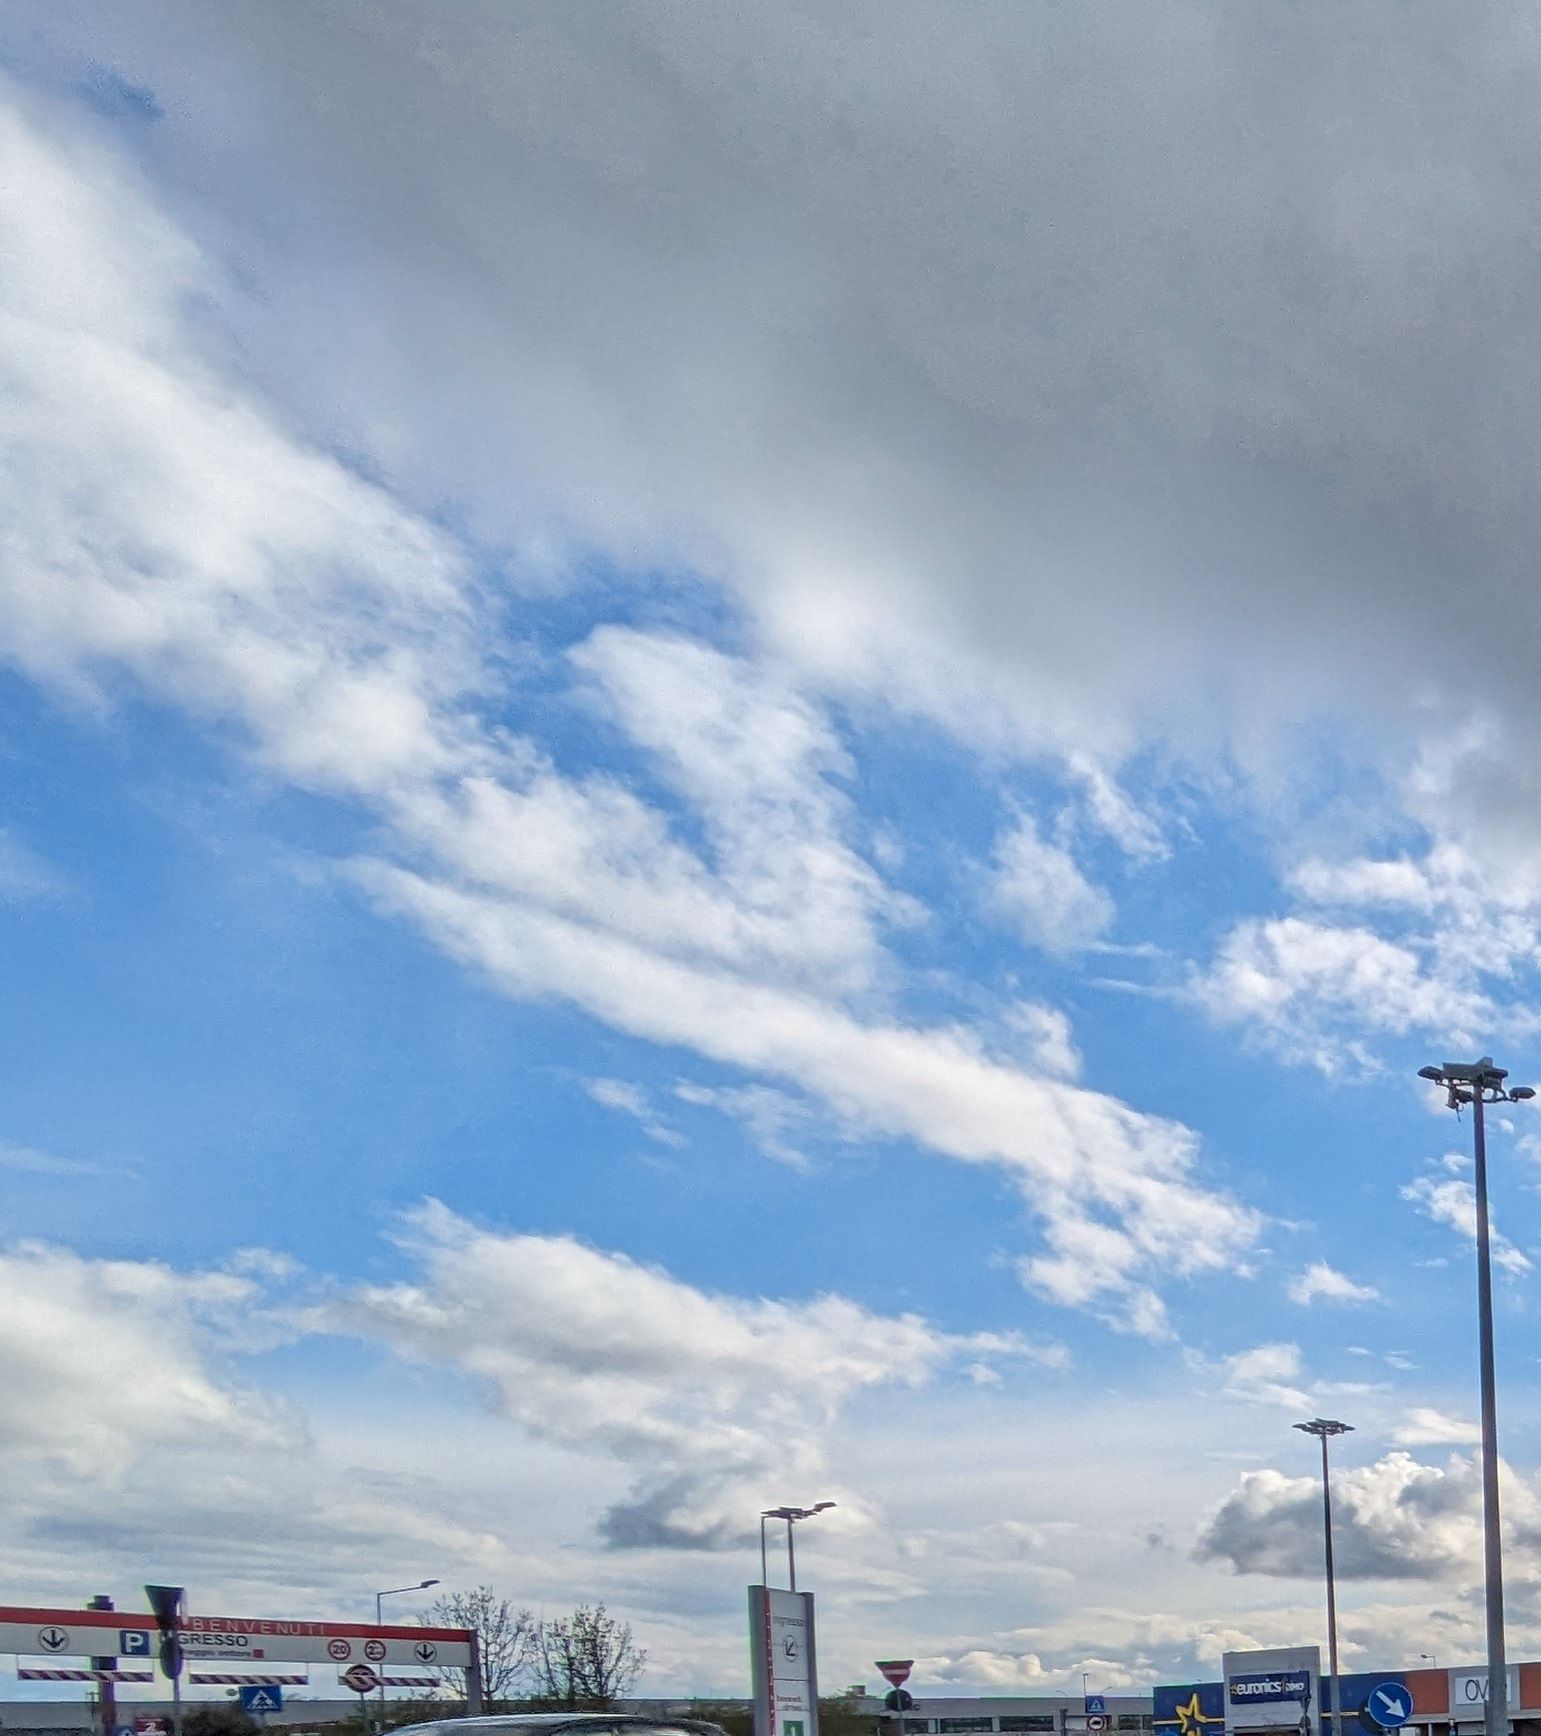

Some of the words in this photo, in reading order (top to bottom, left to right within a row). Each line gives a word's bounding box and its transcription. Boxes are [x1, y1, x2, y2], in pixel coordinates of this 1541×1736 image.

[192, 1616, 325, 1635] BENVENUTI
[126, 1633, 143, 1652] P
[163, 1631, 248, 1647] GRESSO
[1237, 1678, 1282, 1695] euronics
[1465, 1679, 1491, 1701] OV
